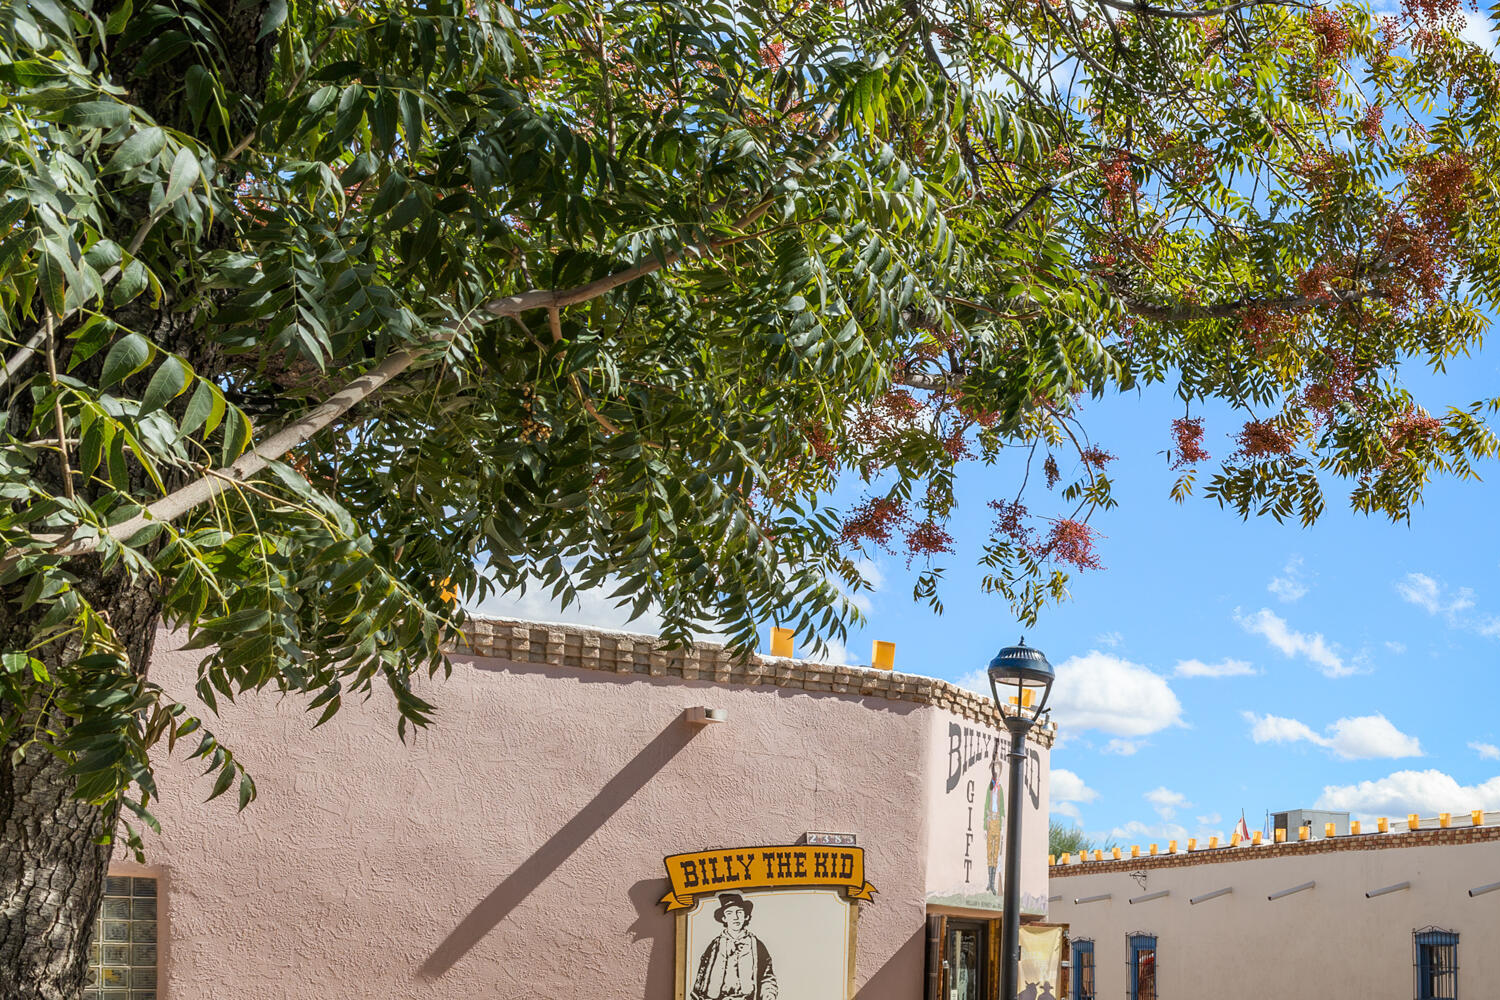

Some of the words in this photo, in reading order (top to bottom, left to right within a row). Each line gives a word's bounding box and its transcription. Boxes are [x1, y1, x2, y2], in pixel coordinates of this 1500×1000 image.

[946, 721, 991, 794] BILLY
[1024, 746, 1040, 810] ID
[680, 853, 755, 888] BILLY
[763, 851, 807, 879] THE
[814, 852, 854, 879] KID
